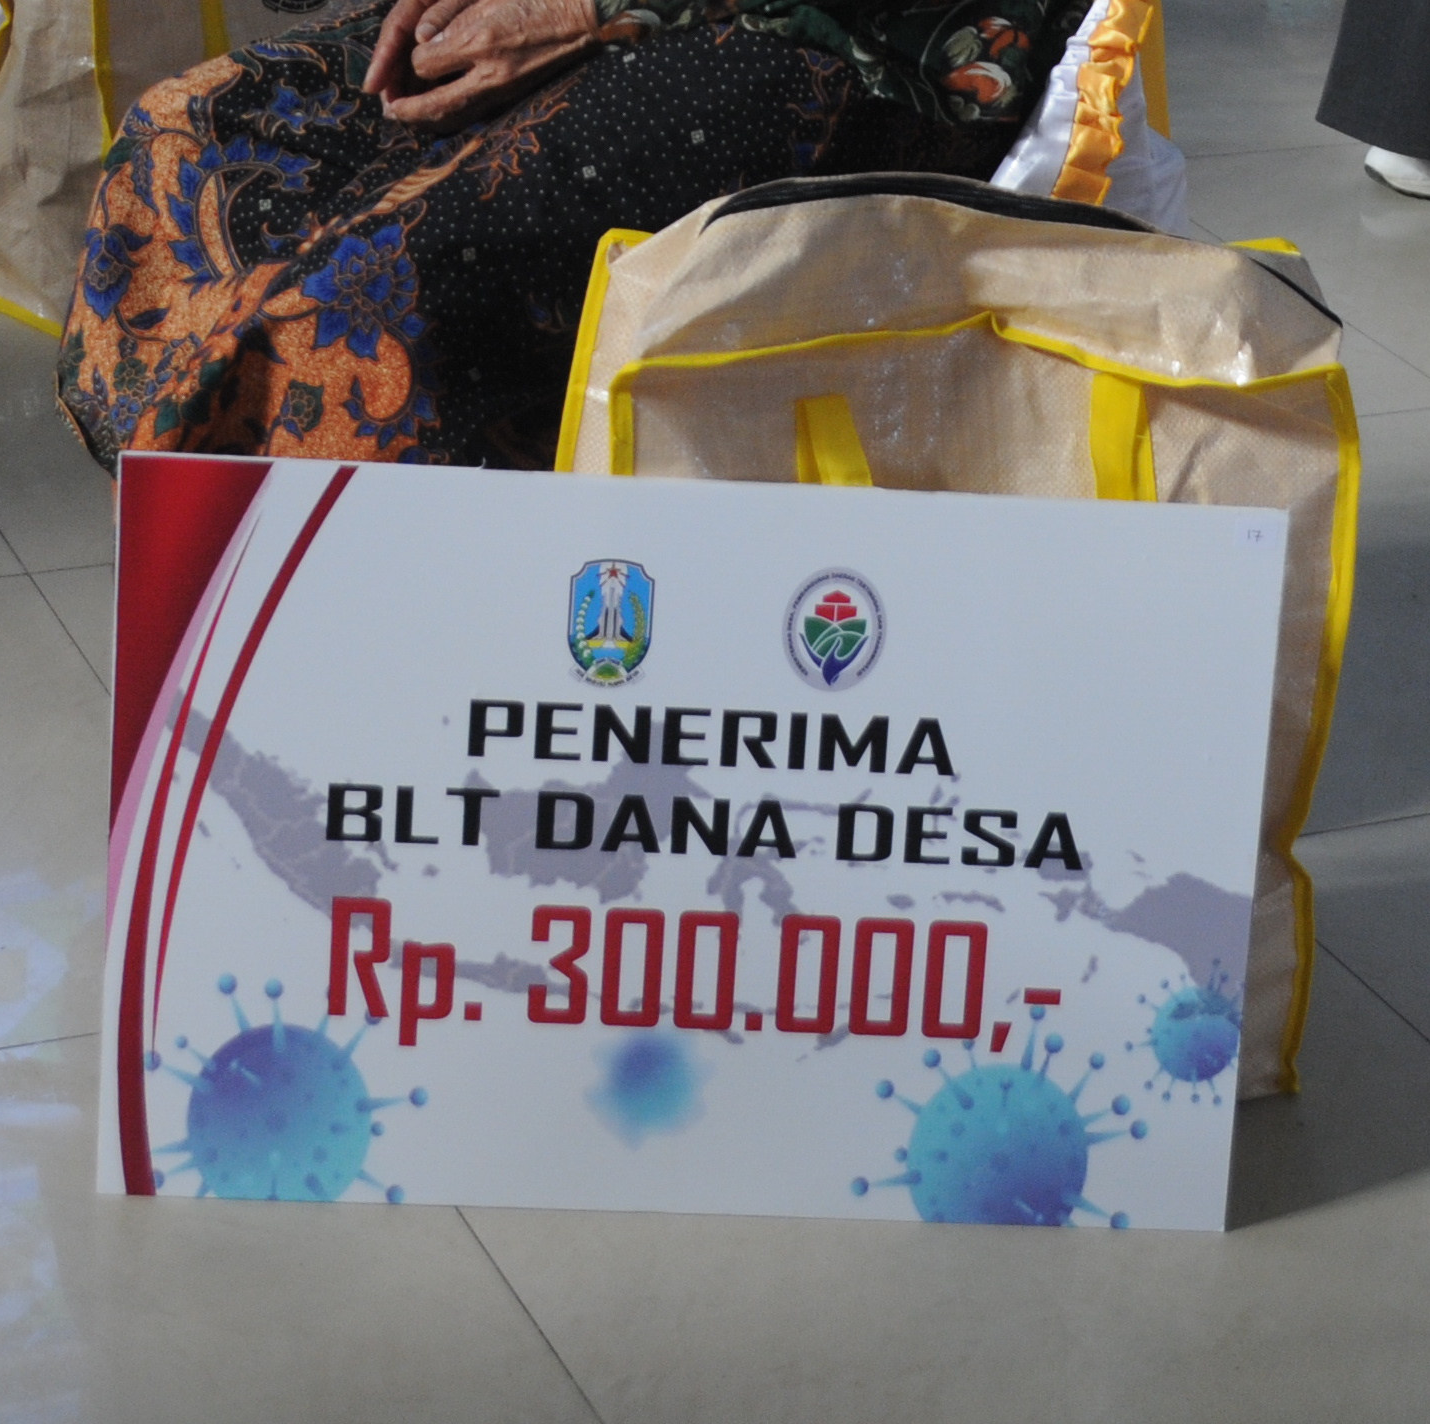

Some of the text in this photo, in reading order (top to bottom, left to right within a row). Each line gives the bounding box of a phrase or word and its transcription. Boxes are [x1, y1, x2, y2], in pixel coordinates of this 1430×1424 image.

[1246, 529, 1264, 543] 17
[469, 700, 954, 776] PENERIMA
[325, 784, 1083, 871] BLT DANA DESA
[329, 897, 1061, 1052] Rp. 300.000,-
